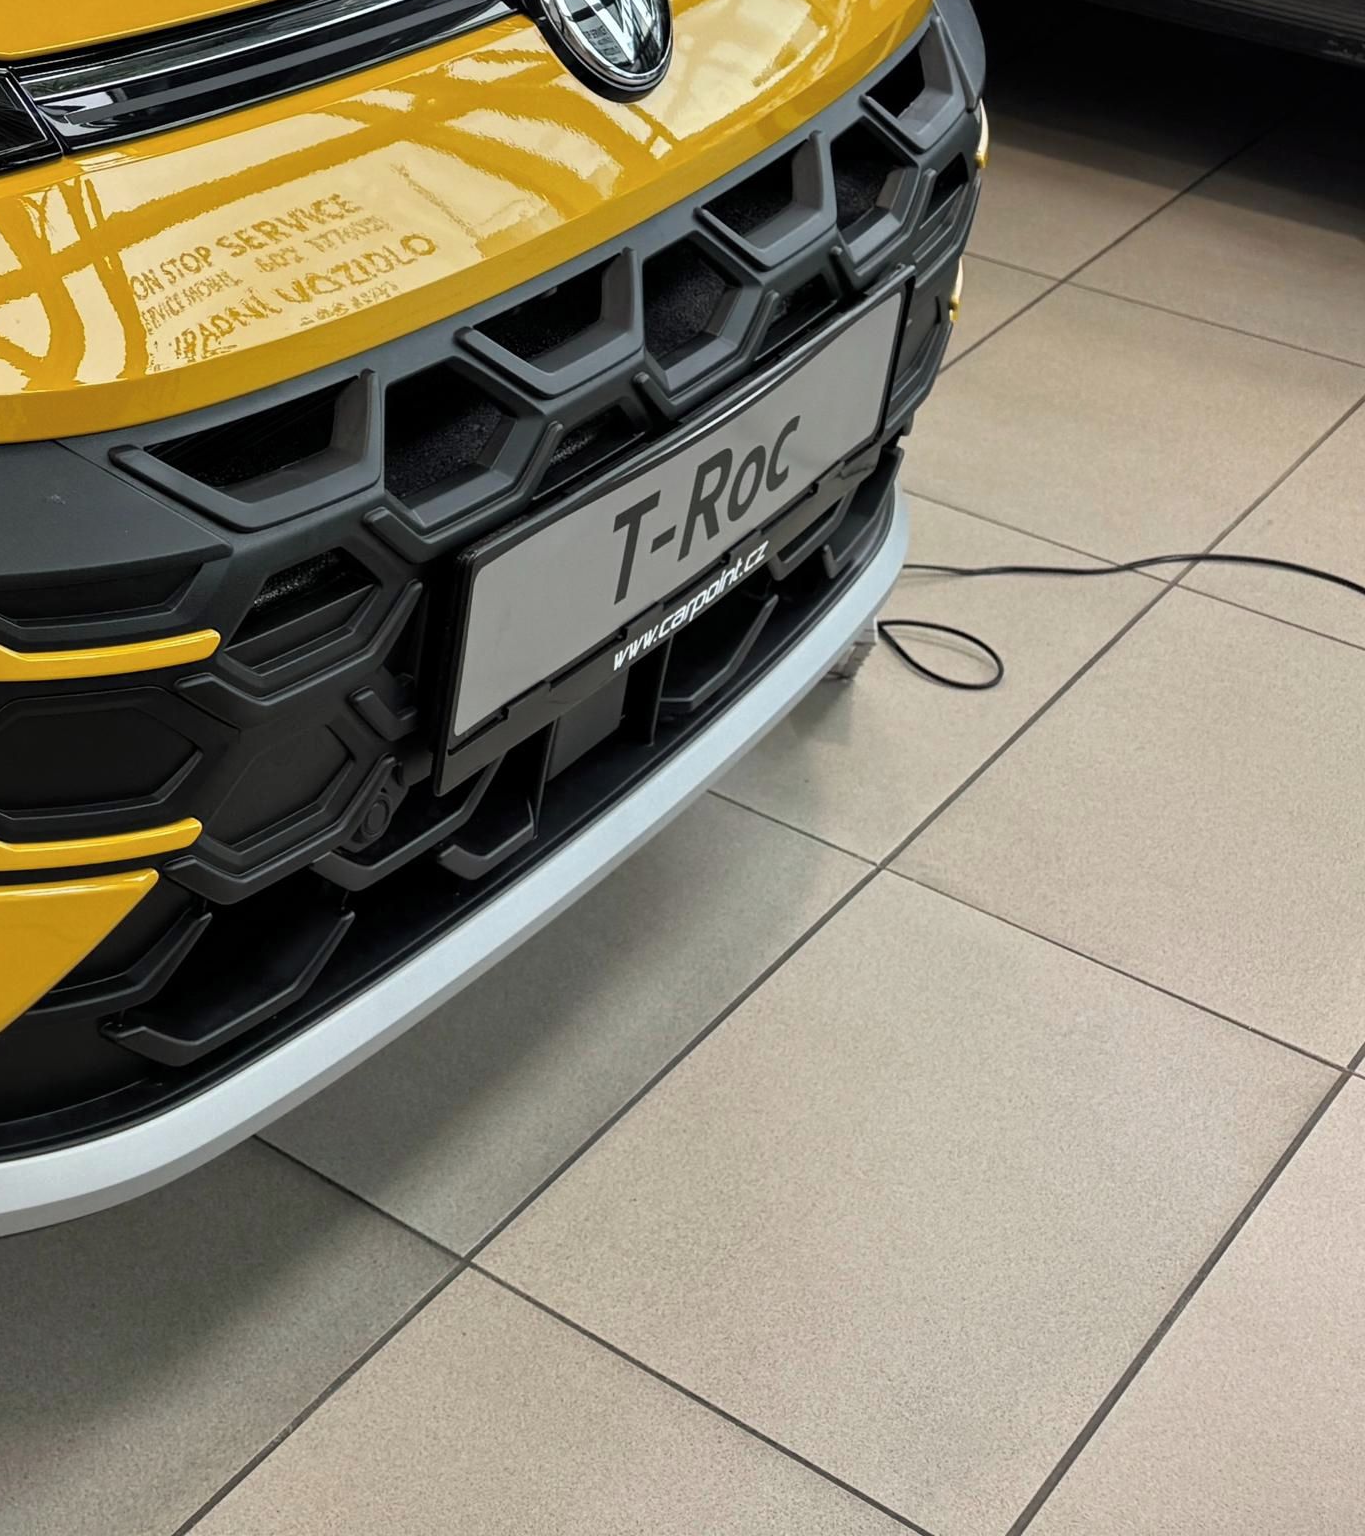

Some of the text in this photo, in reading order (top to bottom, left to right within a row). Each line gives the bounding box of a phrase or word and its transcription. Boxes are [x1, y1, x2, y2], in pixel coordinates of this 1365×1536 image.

[160, 246, 213, 285] STOP
[216, 194, 363, 257] SERVICE
[274, 233, 437, 303] VOZIDLO
[141, 292, 186, 335] ERVICE
[613, 540, 769, 672] www.carpoint.cz
